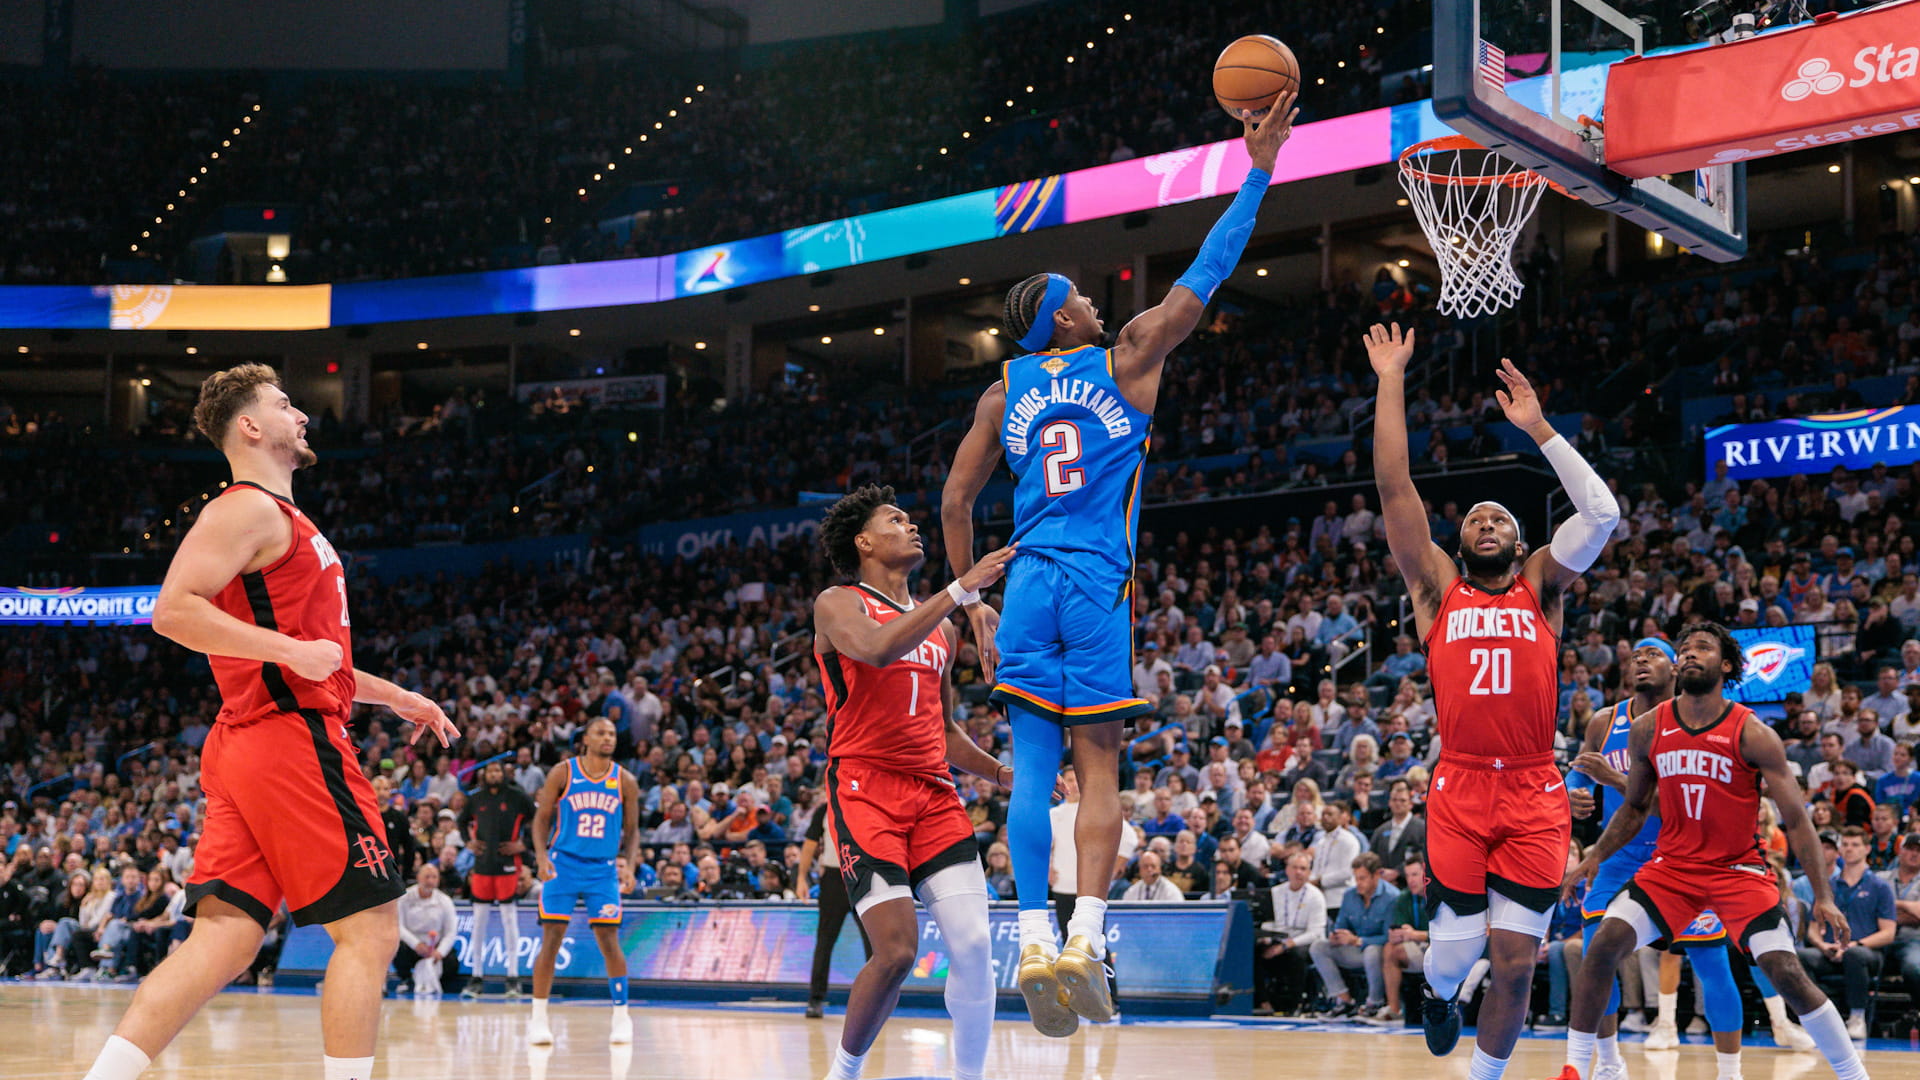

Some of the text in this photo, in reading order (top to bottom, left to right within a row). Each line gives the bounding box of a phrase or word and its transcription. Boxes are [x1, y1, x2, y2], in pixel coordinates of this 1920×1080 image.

[1849, 43, 1919, 88] Sta
[1775, 122, 1900, 151] State
[1006, 378, 1131, 456] GILGEOUS-ALEXANDER
[1040, 420, 1086, 497] 2
[46, 597, 133, 616] FAVORITE
[1445, 607, 1537, 643] ROCKETS
[901, 639, 948, 677] KETS
[1469, 648, 1511, 695] 20
[910, 671, 919, 716] 1
[1656, 749, 1734, 784] ROCKETS
[567, 791, 620, 814] THUNDER
[1680, 783, 1707, 820] 17
[576, 813, 606, 838] 22
[453, 935, 576, 970] OLYMPIS
